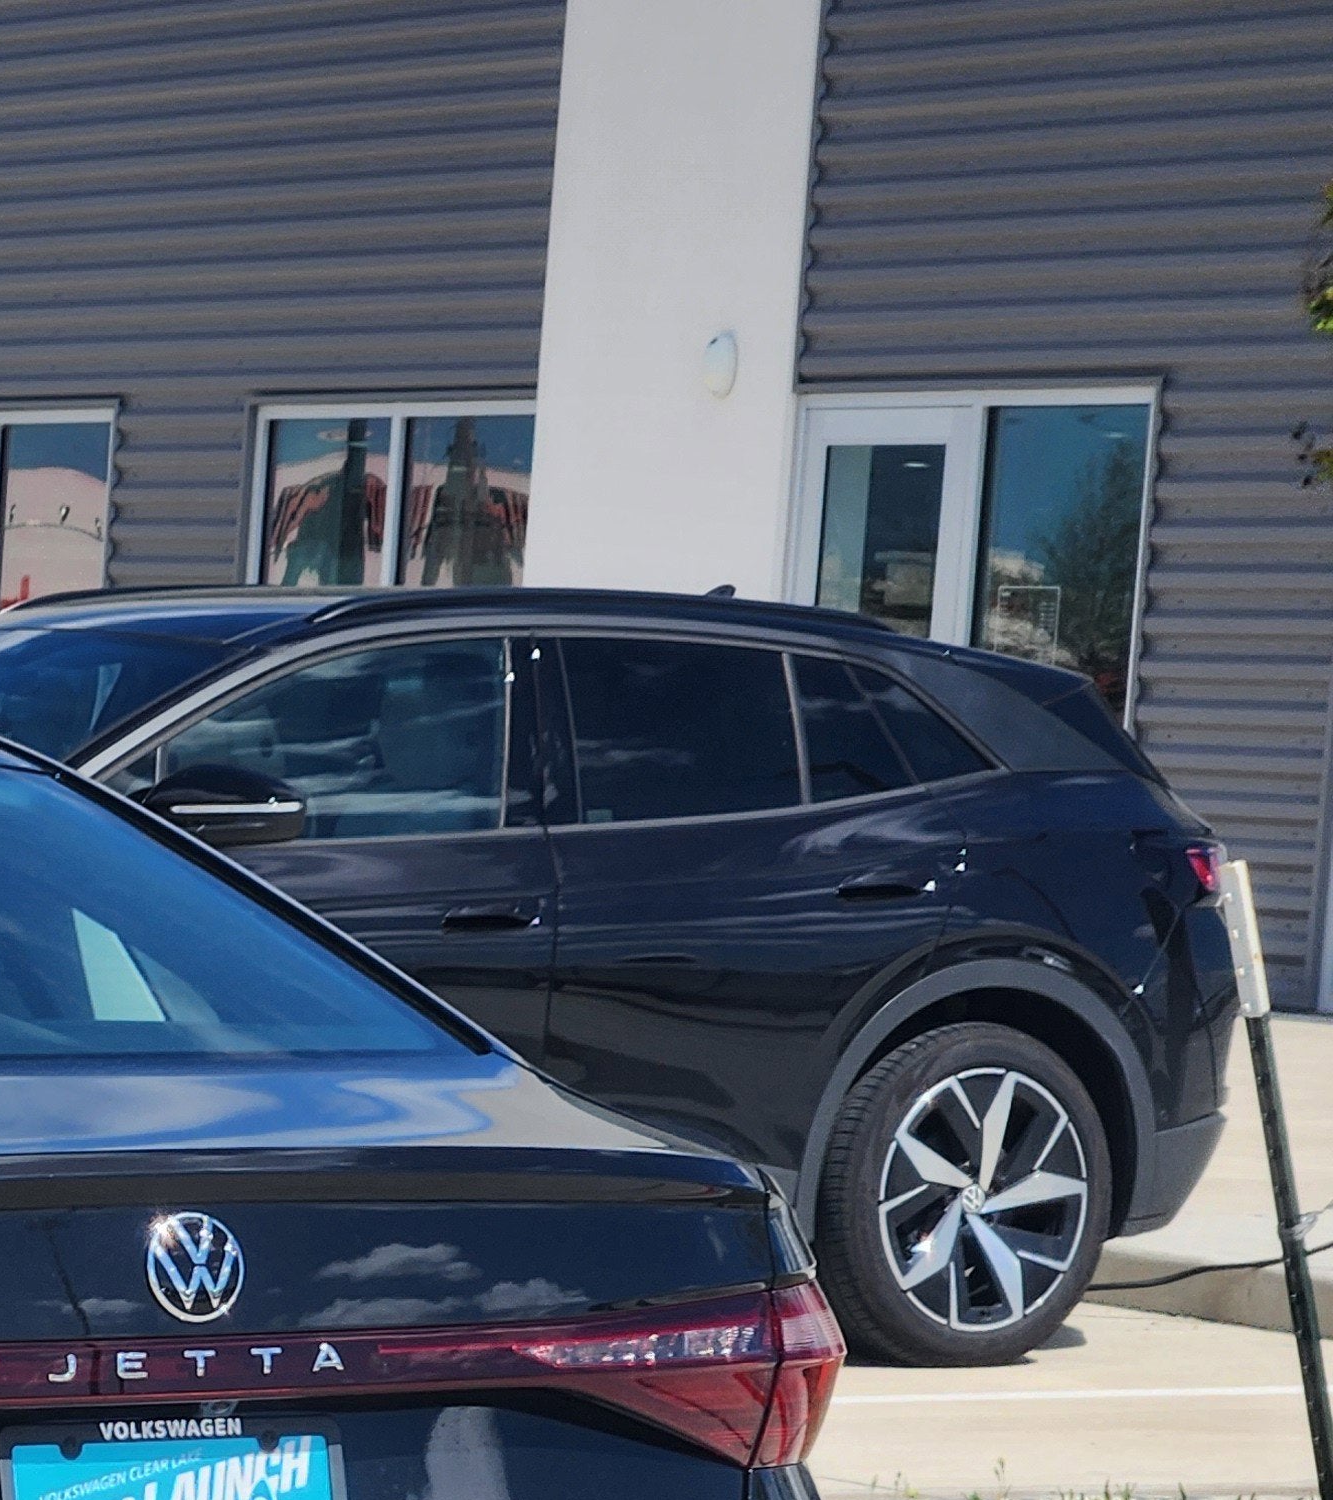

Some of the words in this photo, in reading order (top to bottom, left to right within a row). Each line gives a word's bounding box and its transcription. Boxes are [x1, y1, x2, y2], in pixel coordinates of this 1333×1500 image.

[147, 1211, 245, 1323] VW
[48, 1342, 345, 1383] JETTA
[99, 1417, 242, 1441] VOLKSWAGEN
[129, 1459, 169, 1482] CLEAR
[171, 1448, 203, 1468] LAKE
